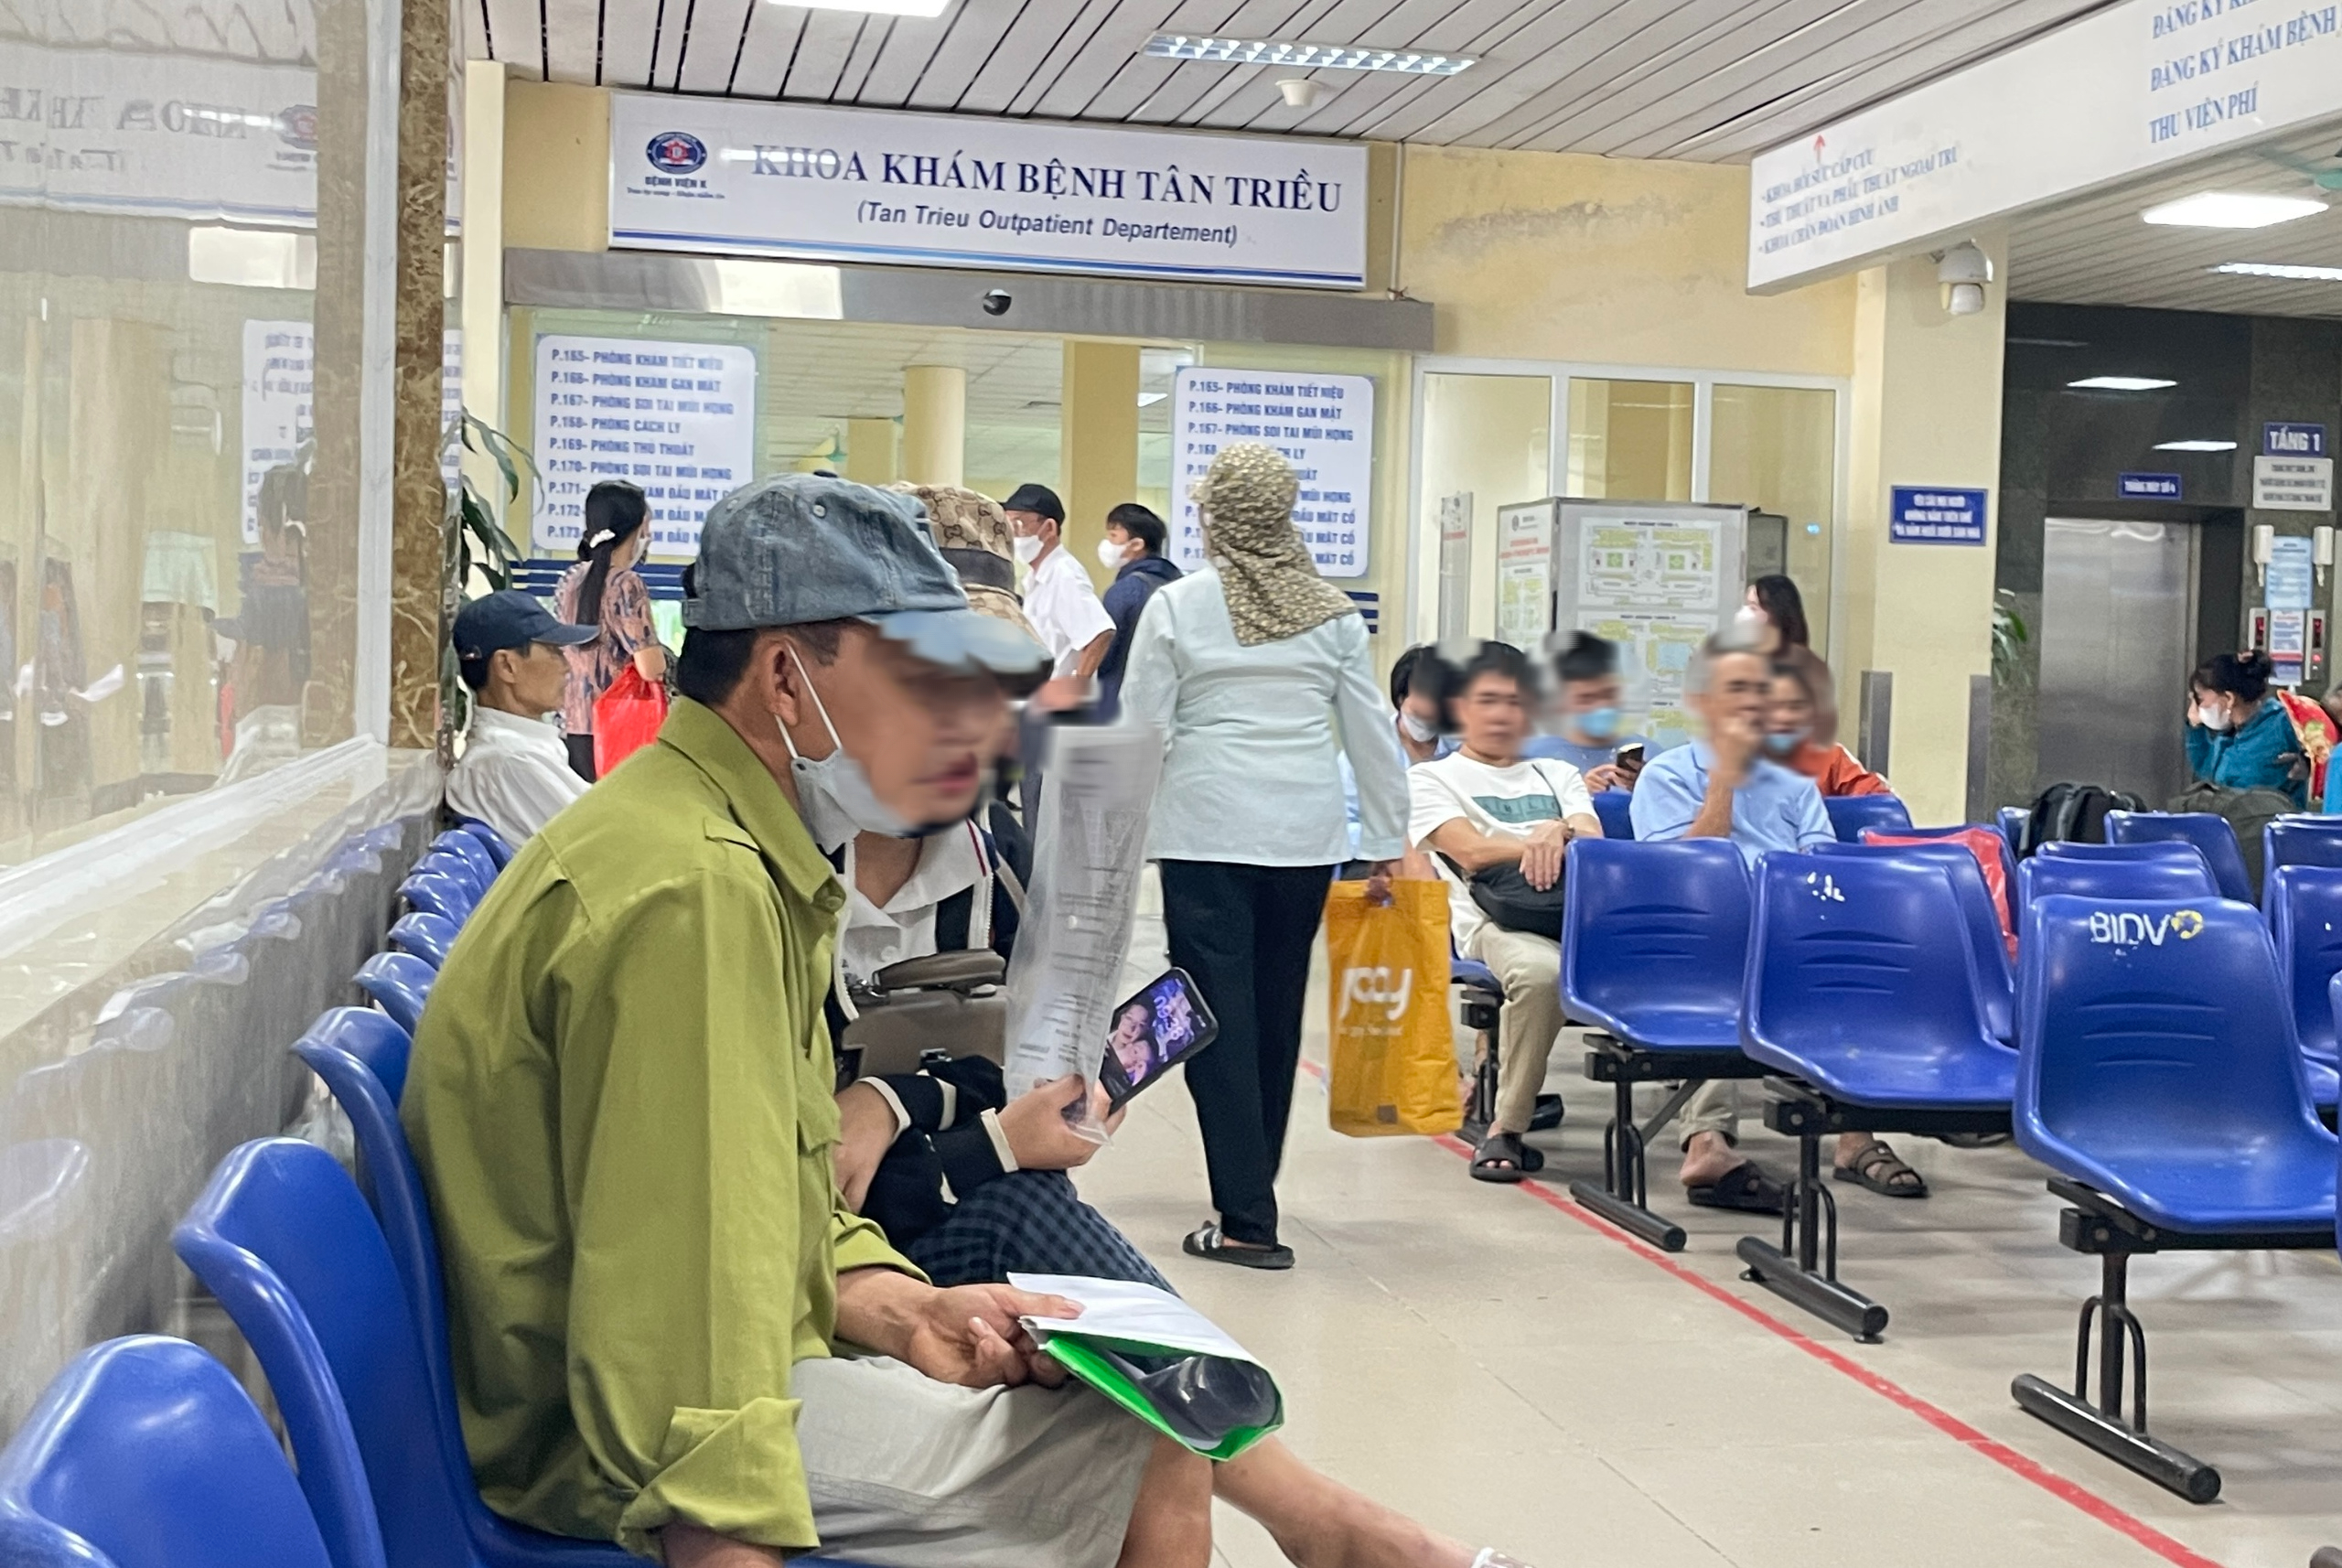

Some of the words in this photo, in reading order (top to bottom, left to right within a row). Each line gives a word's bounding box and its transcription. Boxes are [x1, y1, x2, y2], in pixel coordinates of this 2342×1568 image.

[2227, 23, 2283, 66] KHÁM
[2286, 5, 2337, 47] BỆNH
[2228, 81, 2260, 119] PHÍ
[752, 145, 868, 182] KHOA
[881, 149, 1006, 191] KHÁM
[1017, 157, 1125, 200] BỆNH
[1136, 165, 1215, 204] TÂN
[1225, 168, 1341, 212] TRIỀU
[857, 199, 907, 223] (Tan
[915, 205, 970, 227] Trieu
[979, 209, 1092, 238] Outpatient
[1101, 218, 1238, 248] Departement)
[2270, 425, 2309, 451] TẦNG
[2313, 433, 2320, 451] 1
[2090, 911, 2171, 946] BIDV
